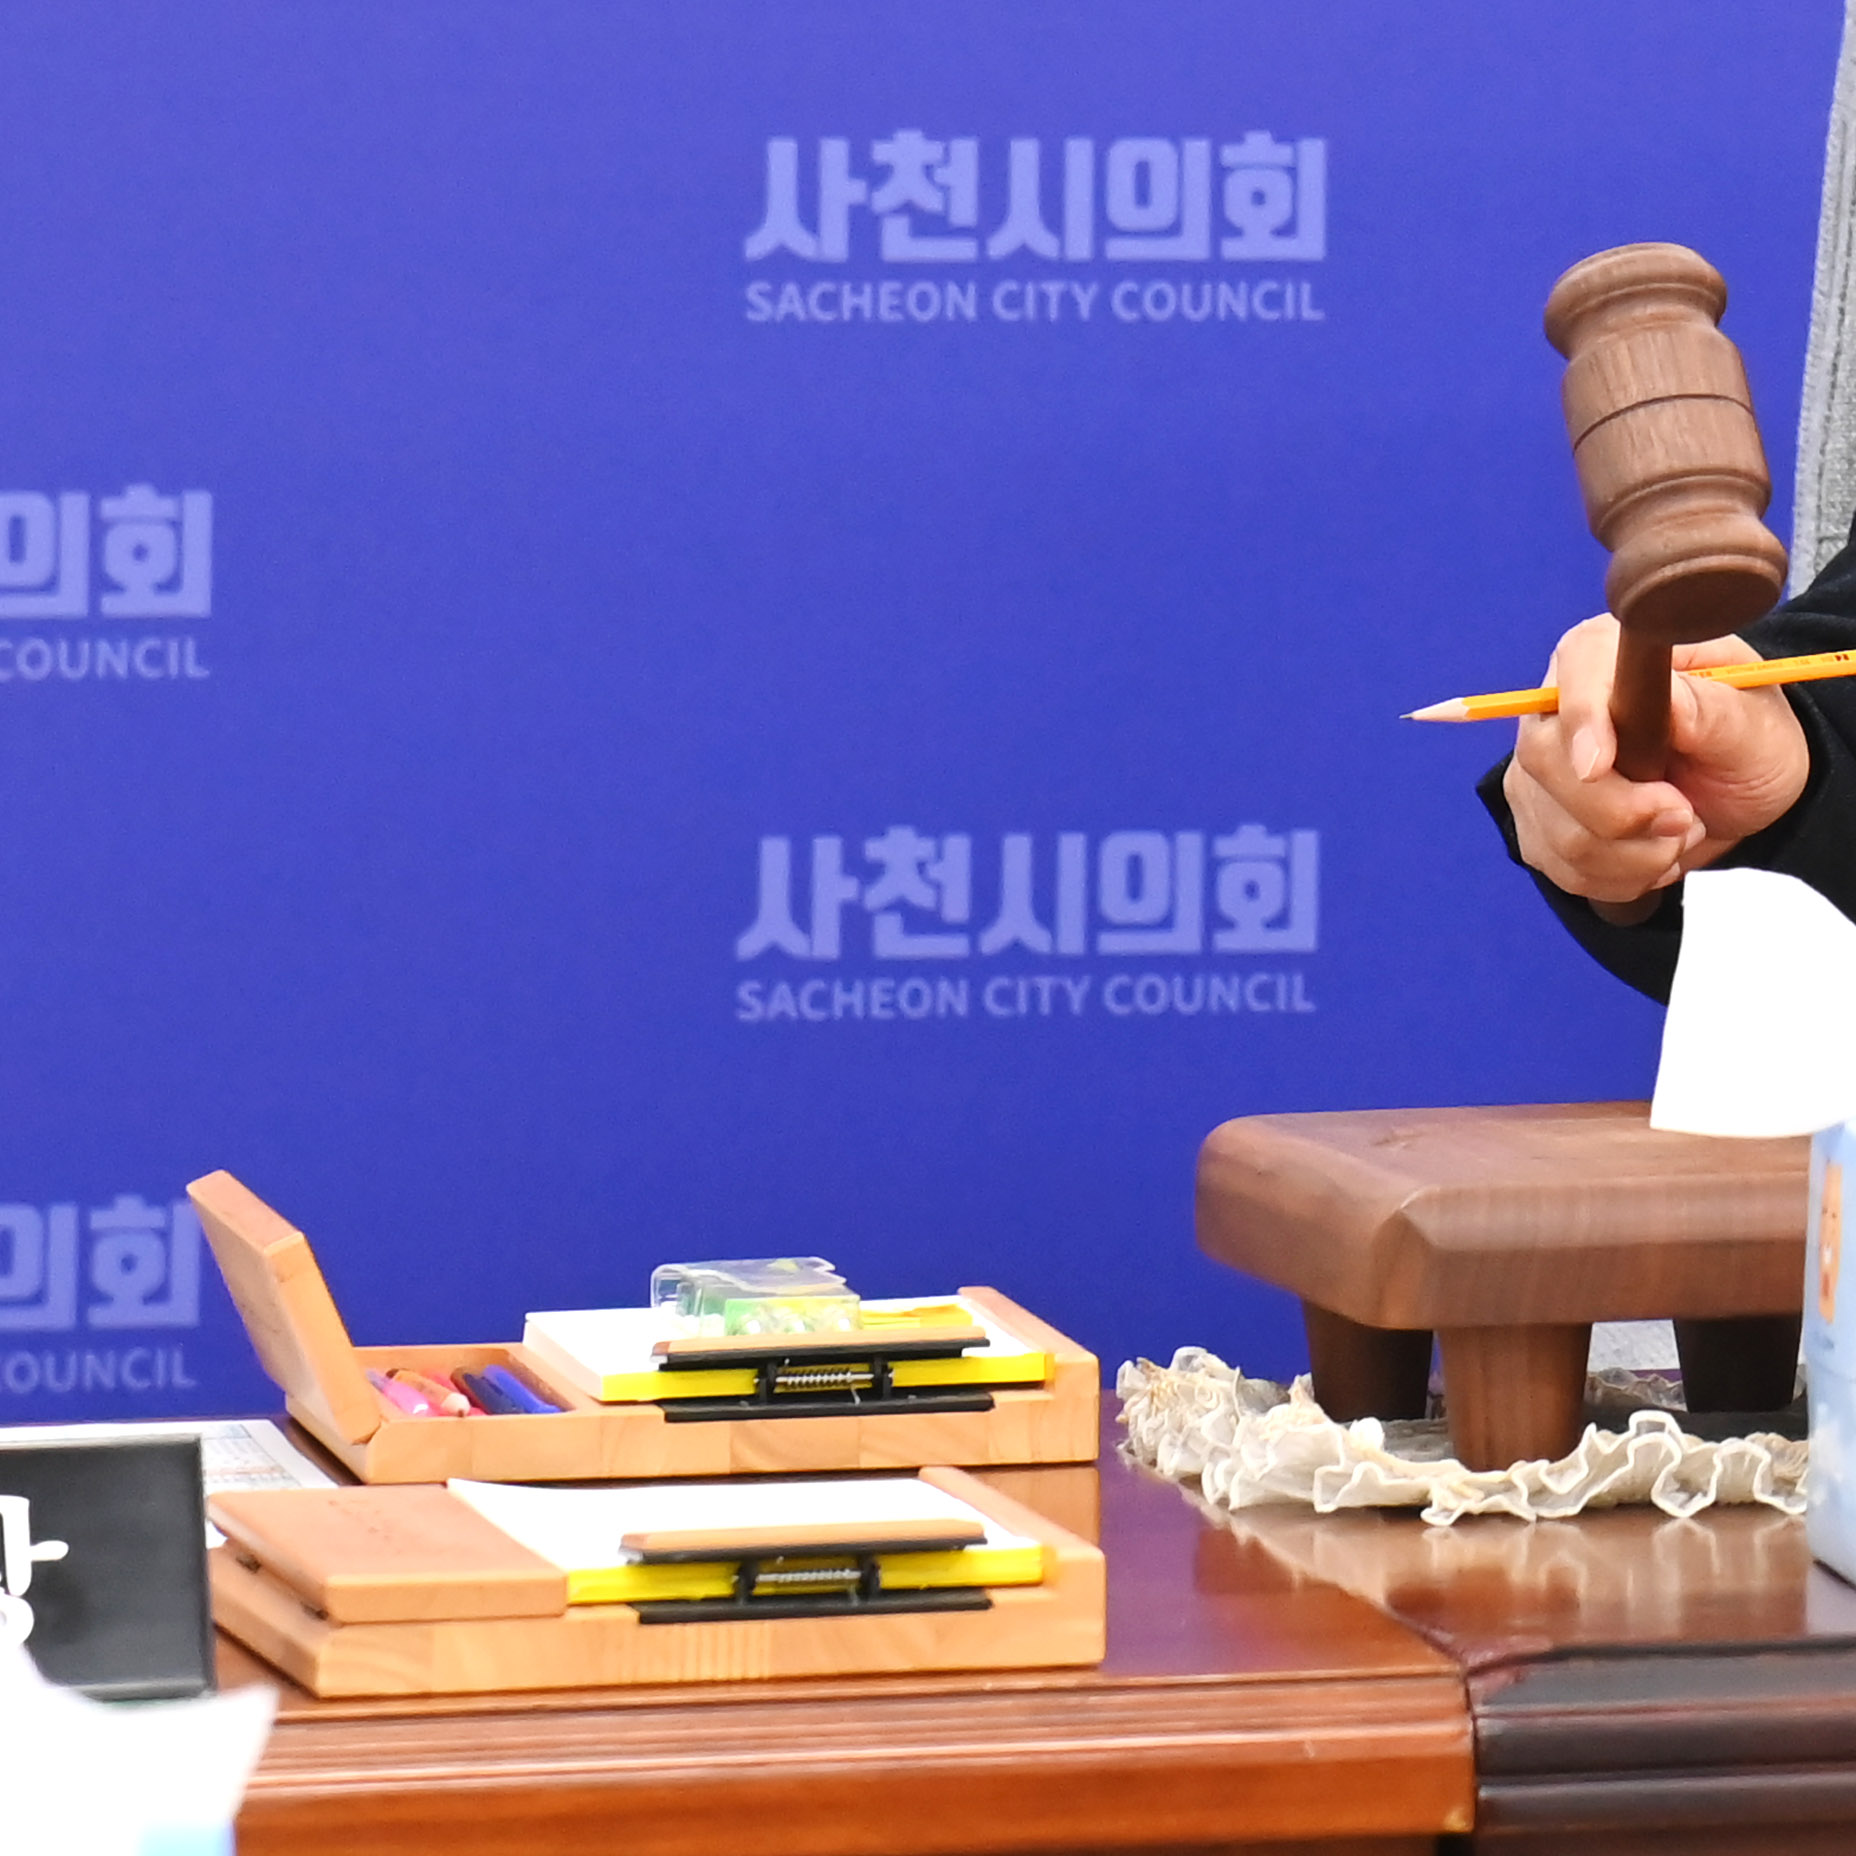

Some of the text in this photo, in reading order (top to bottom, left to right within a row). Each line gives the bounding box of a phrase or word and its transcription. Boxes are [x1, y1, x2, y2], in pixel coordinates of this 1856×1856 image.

[743, 129, 1327, 263] 사천시의회
[745, 280, 1324, 323] SACHEON CITY COUNCIL
[735, 823, 1320, 961] 사천시의회
[737, 973, 1315, 1022] SACHEON CITY COUNCIL
